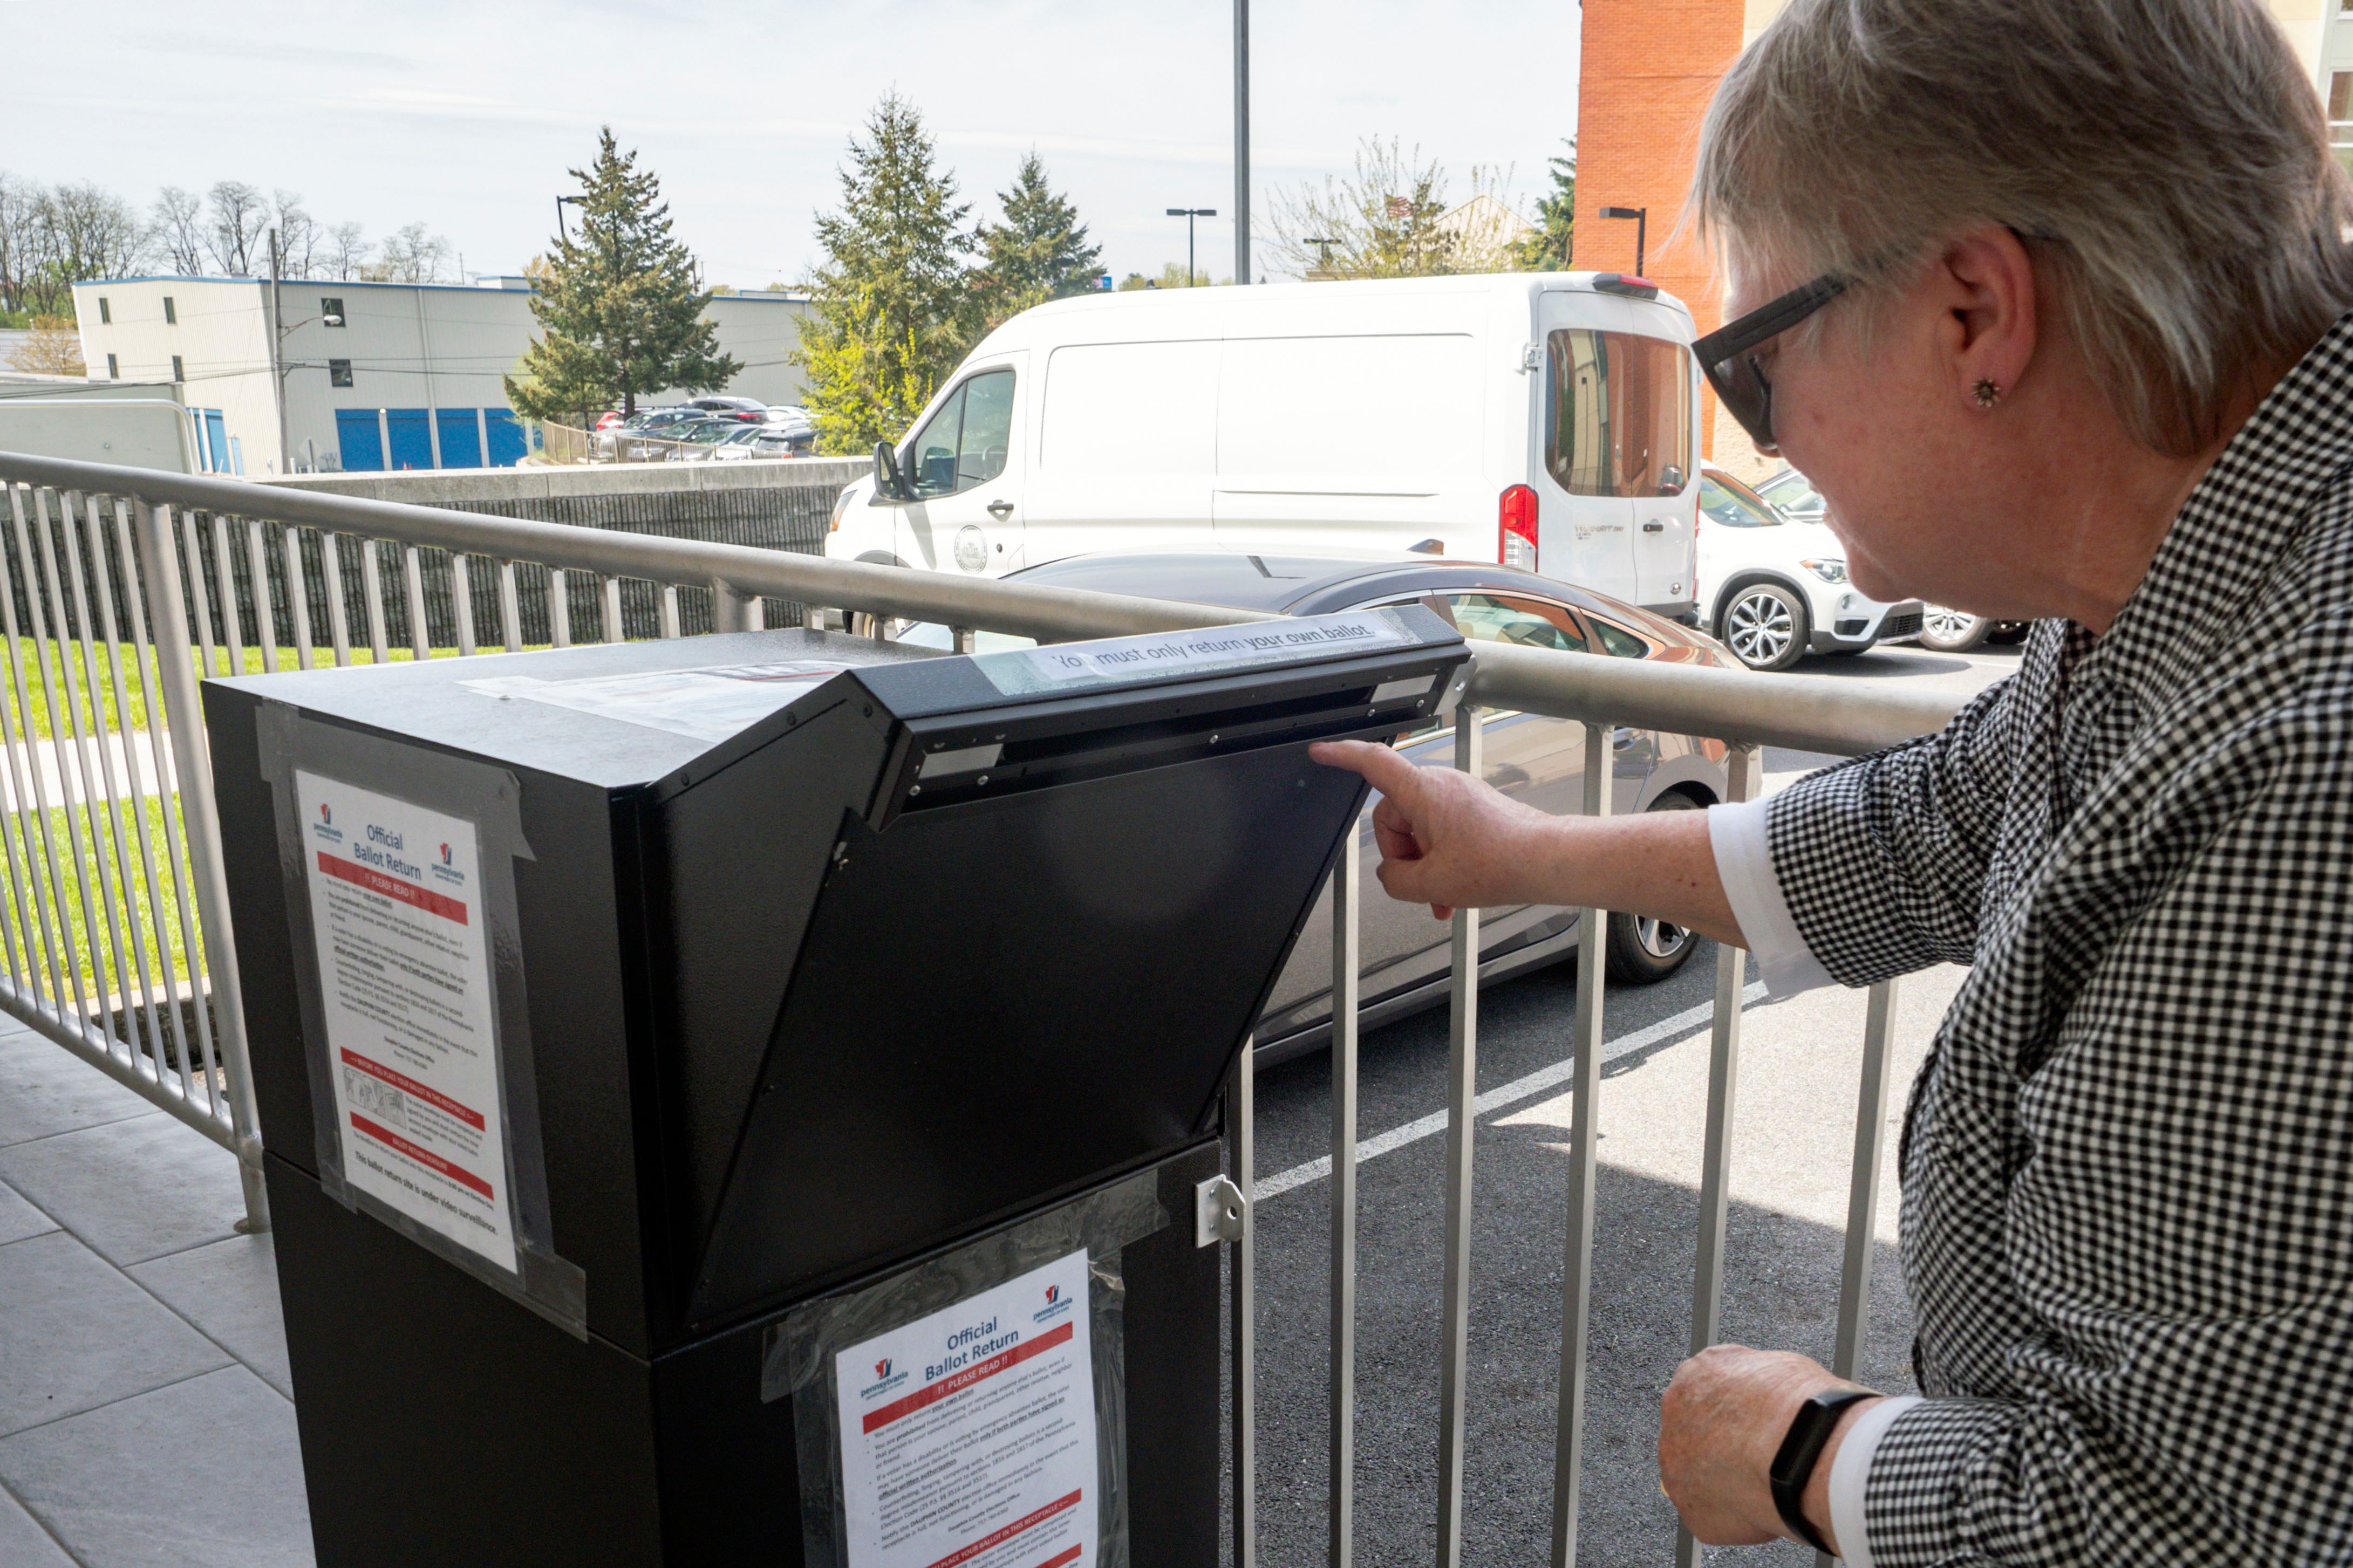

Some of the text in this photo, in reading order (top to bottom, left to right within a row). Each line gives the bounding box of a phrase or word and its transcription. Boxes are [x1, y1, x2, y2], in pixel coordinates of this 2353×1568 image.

[1051, 624, 1376, 668] Yo must only return your own ballot.
[366, 824, 403, 851] Official
[353, 842, 385, 867] Ballot
[385, 853, 421, 880] Return
[371, 875, 409, 897] PLEASE READ
[354, 1151, 367, 1165] This
[384, 1169, 403, 1184] return
[403, 1179, 414, 1190] site
[414, 1183, 420, 1194] is
[420, 1189, 439, 1203] under
[440, 1199, 458, 1214] video
[1033, 1297, 1073, 1321] pennsylvania
[947, 1316, 997, 1350] Official
[925, 1330, 1019, 1381] Ballot Return
[861, 1371, 909, 1398] pennsylvania
[948, 1370, 976, 1389] PLEASE
[978, 1359, 1000, 1375] READ
[885, 1422, 900, 1433] must
[901, 1417, 912, 1427] only
[913, 1408, 931, 1420] return
[931, 1403, 944, 1413] your
[945, 1396, 958, 1406] own
[878, 1486, 898, 1501] official
[898, 1476, 920, 1491] written
[940, 1555, 959, 1568] PLACE
[960, 1544, 978, 1557] YOUR
[979, 1532, 1001, 1549] BALLOT
[1010, 1521, 1024, 1532] THIS
[1024, 1503, 1058, 1525] RECEPTACLE
